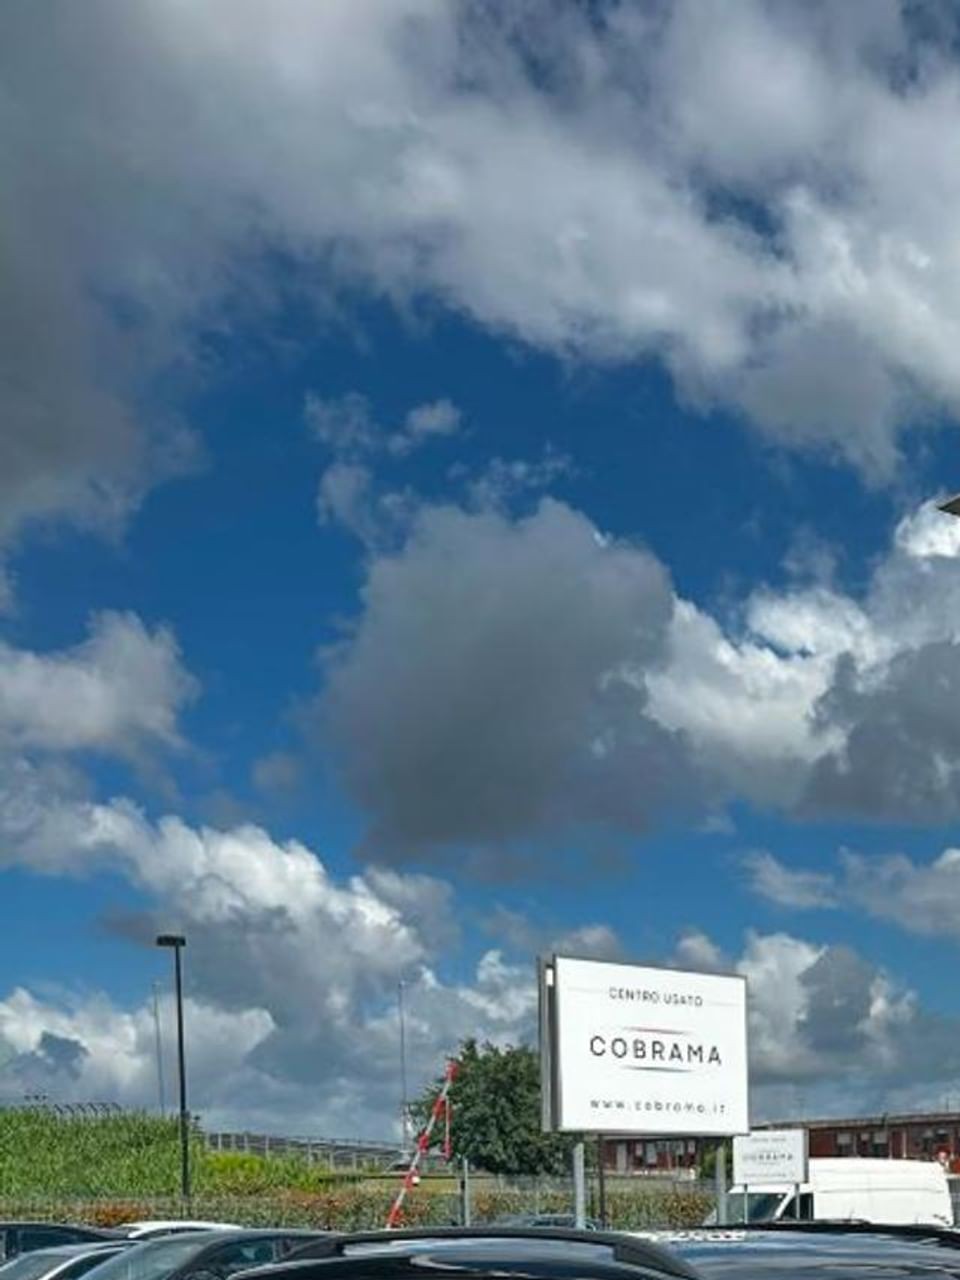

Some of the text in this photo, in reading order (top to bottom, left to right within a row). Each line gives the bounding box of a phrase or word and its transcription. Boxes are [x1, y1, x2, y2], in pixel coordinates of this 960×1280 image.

[609, 987, 704, 1007] CENTRO USATO
[590, 1035, 722, 1065] COBRAMA
